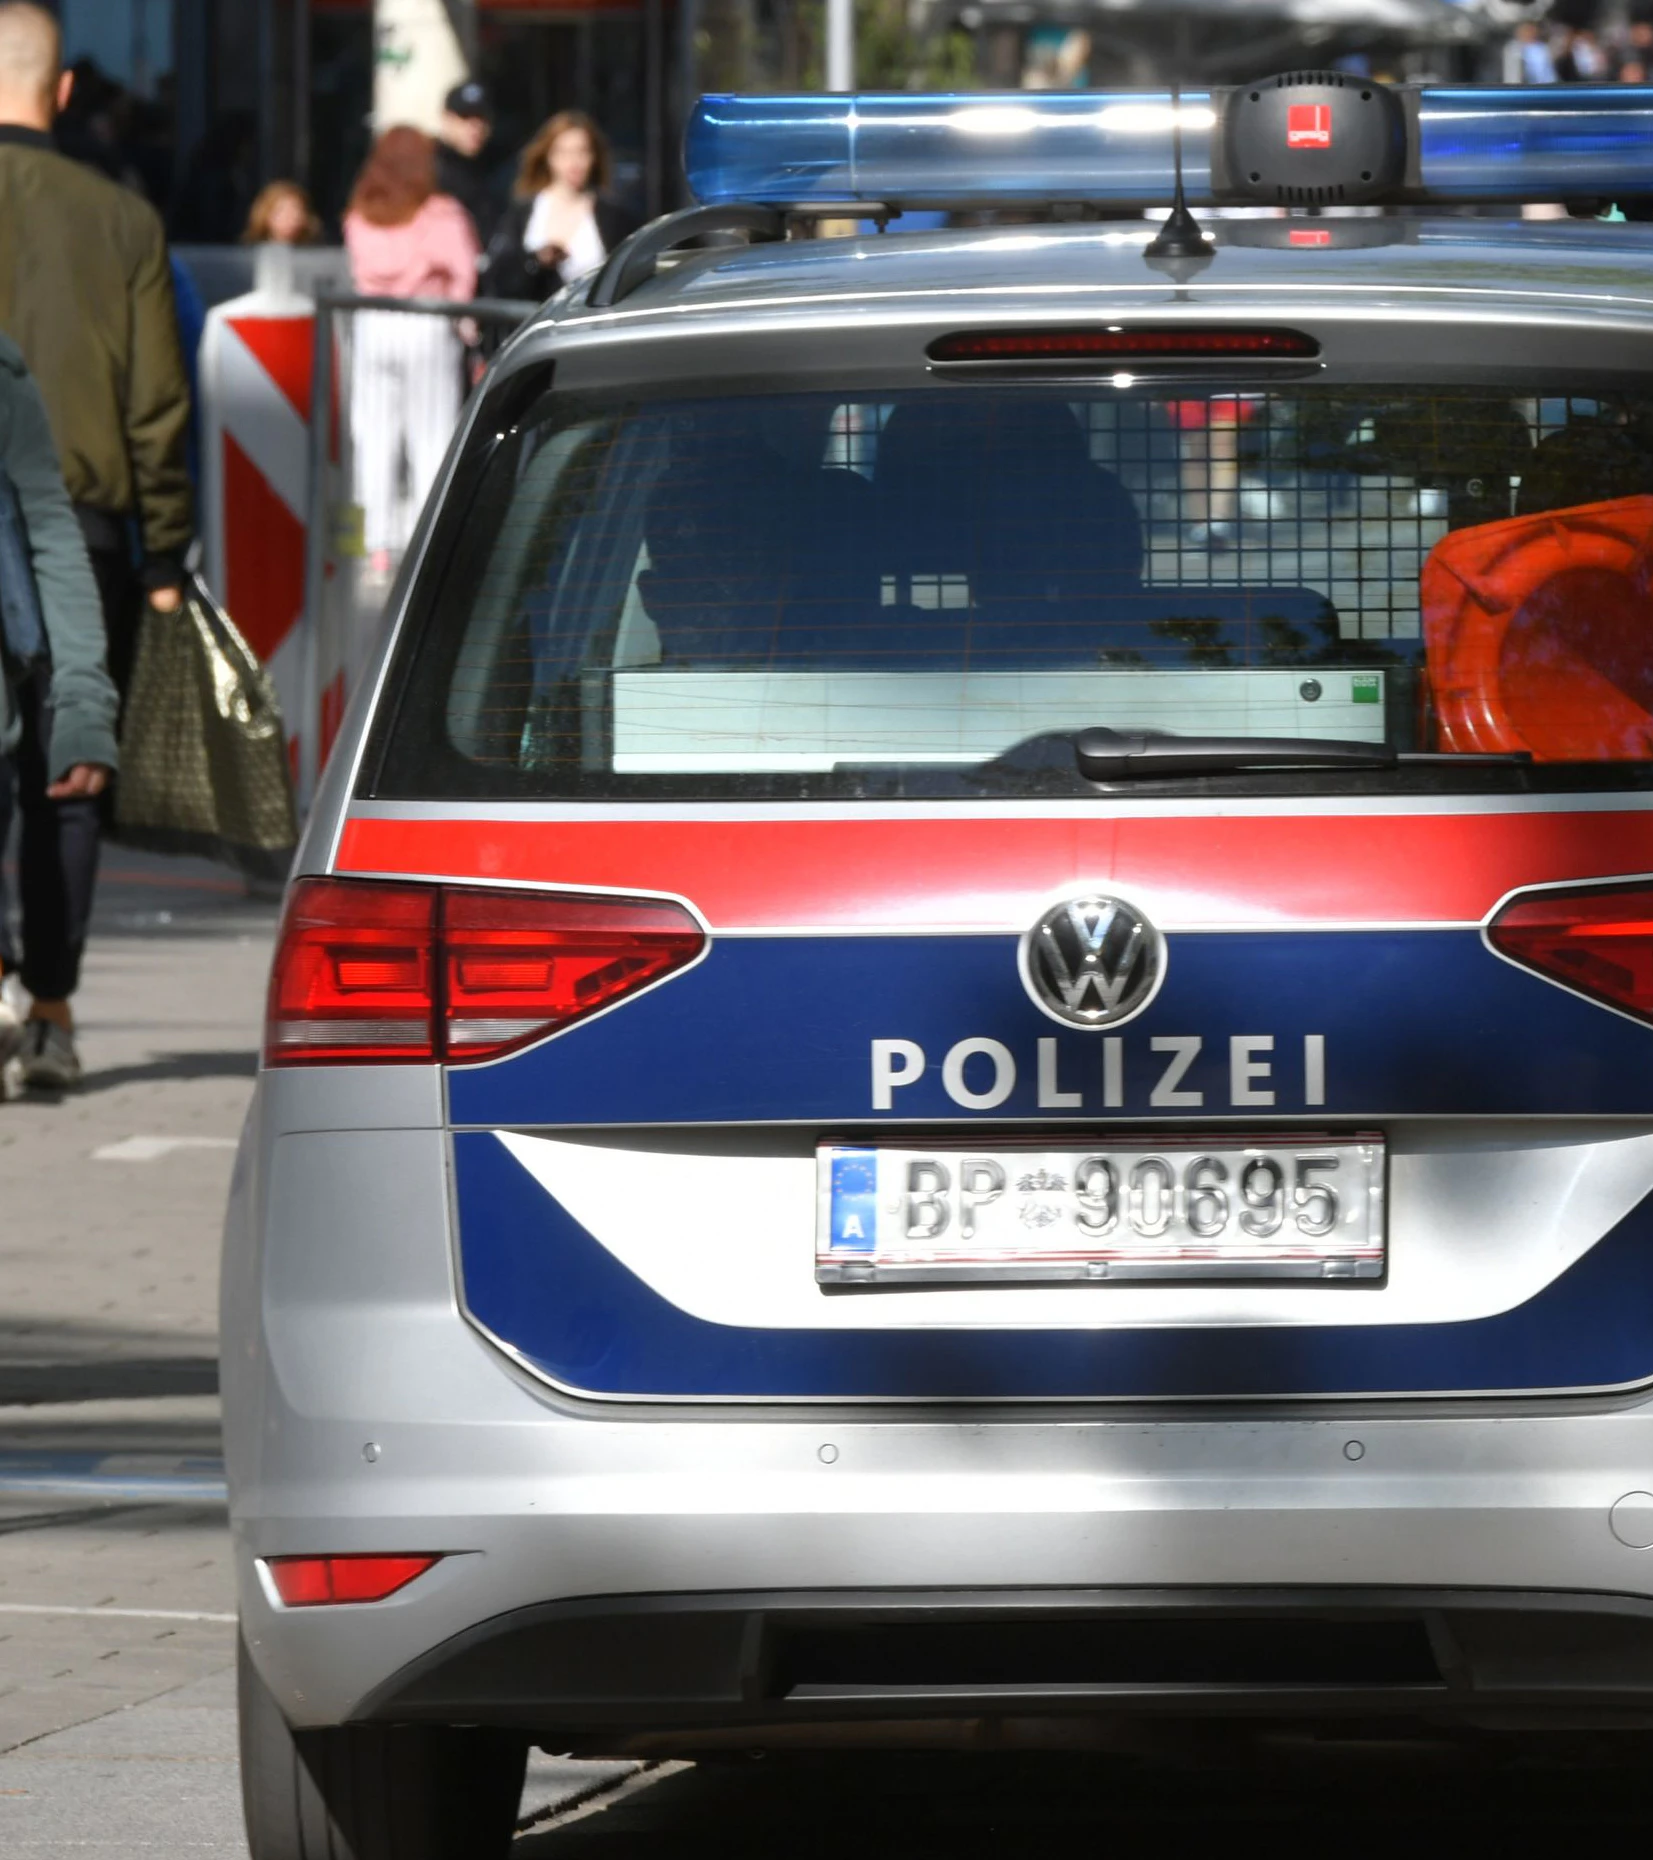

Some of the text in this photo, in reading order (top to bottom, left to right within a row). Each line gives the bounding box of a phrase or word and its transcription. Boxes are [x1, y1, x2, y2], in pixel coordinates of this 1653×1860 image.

[871, 1035, 1325, 1109] POLIZEI
[842, 1214, 866, 1239] A
[905, 1155, 1340, 1239] BP 90695
